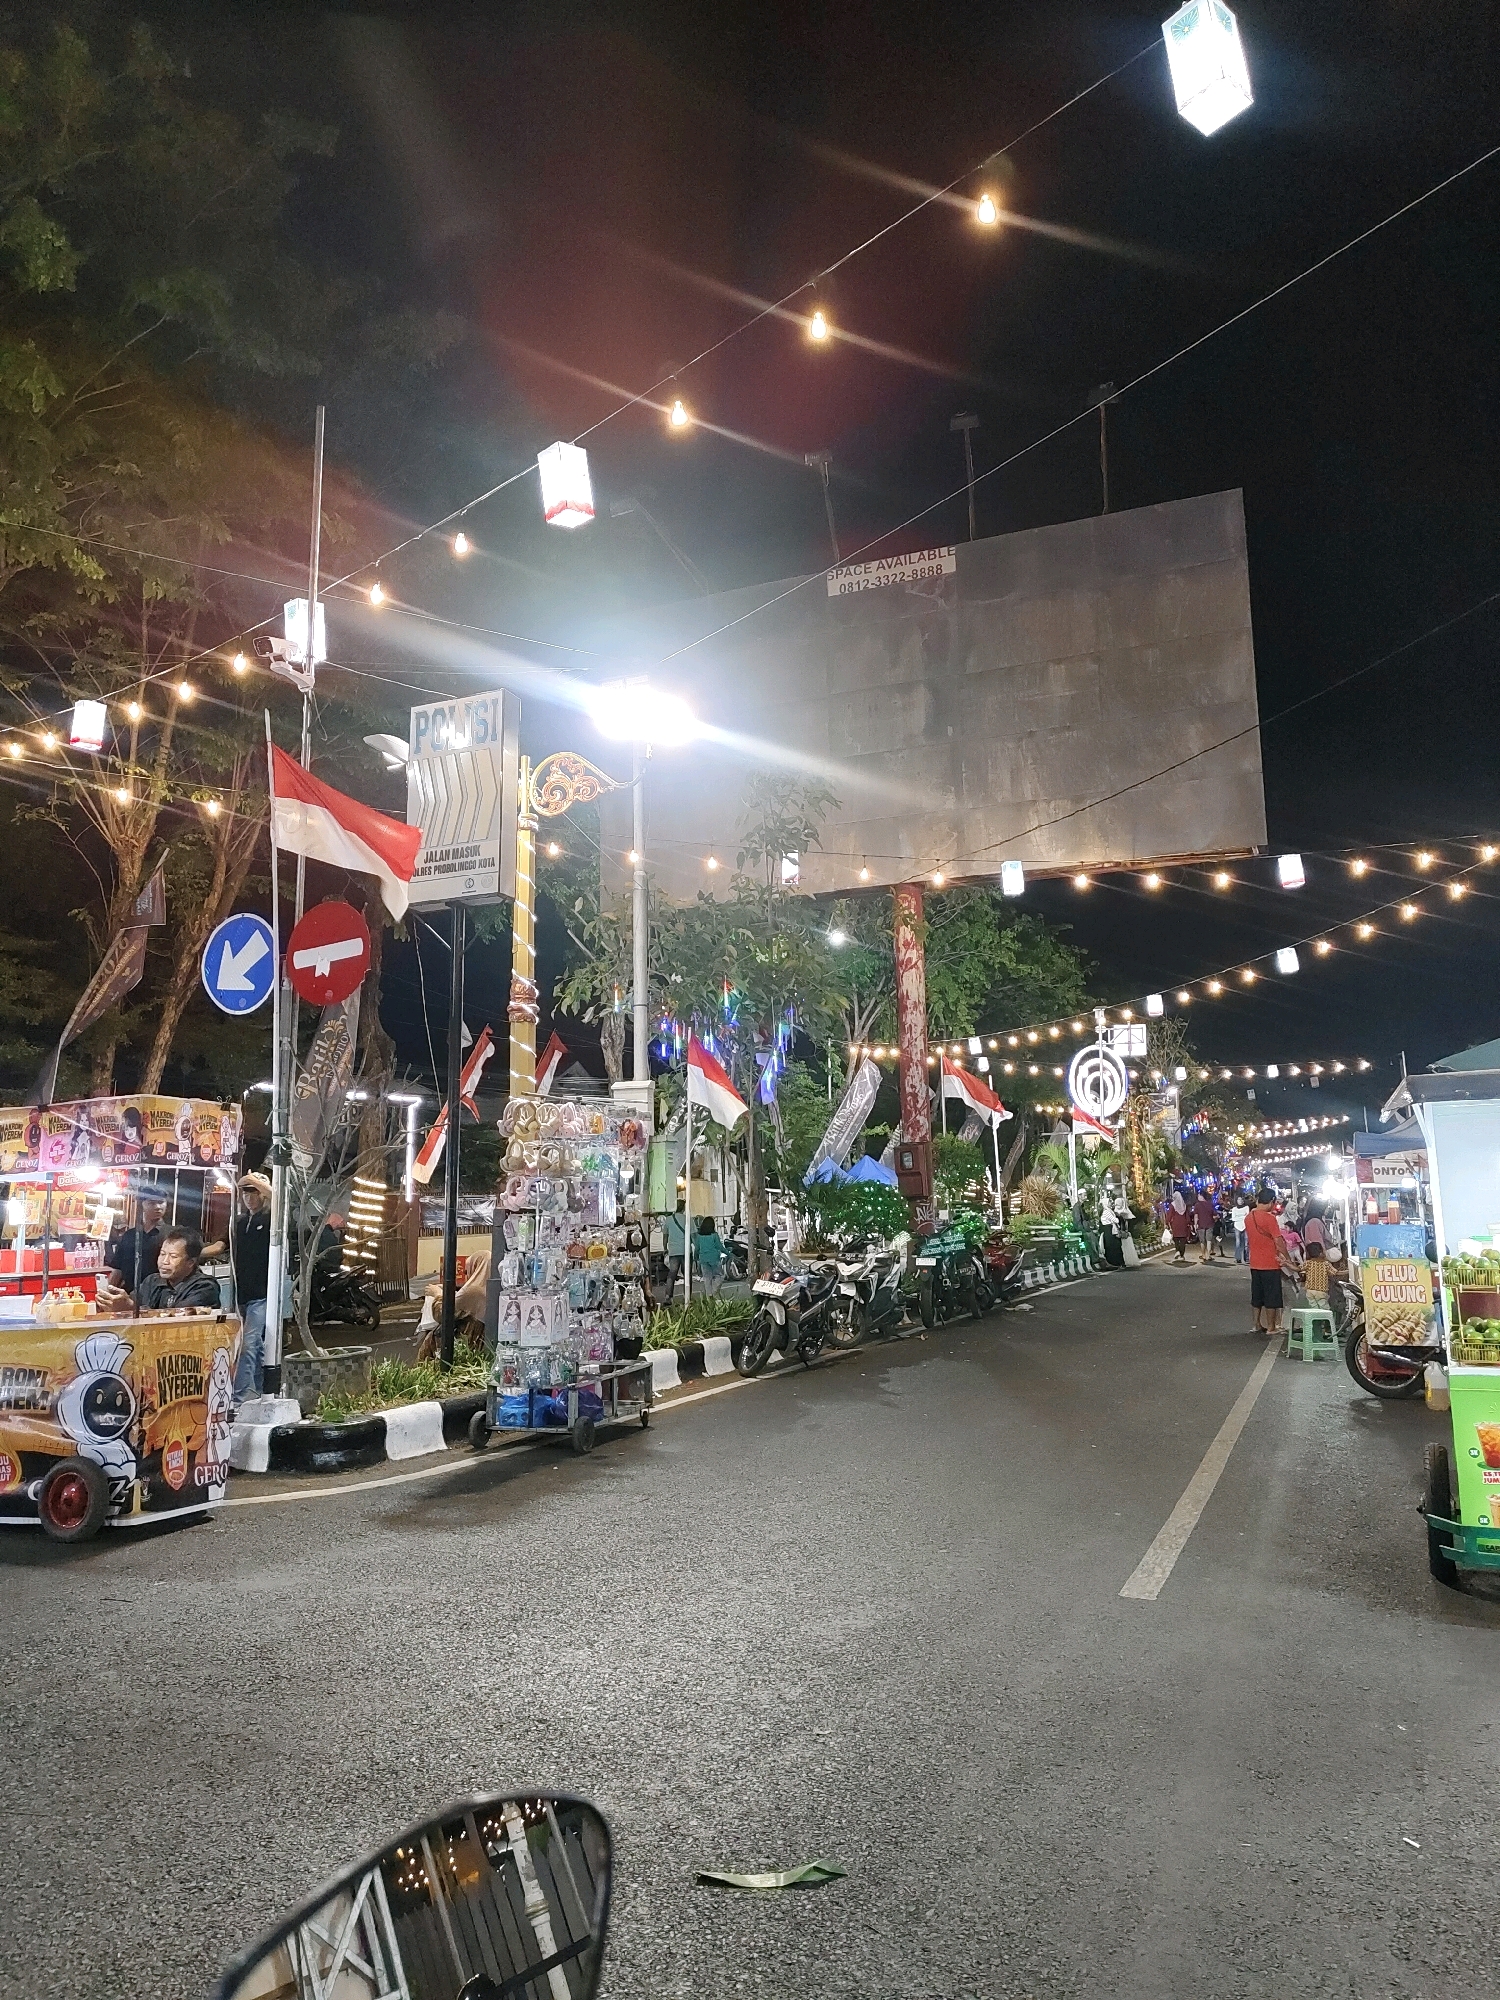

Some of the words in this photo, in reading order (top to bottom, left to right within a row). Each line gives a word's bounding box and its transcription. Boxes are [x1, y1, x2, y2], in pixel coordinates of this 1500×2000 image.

[827, 563, 872, 581] SPACE
[876, 547, 956, 572] AVAILABLE
[839, 564, 943, 593] 0812-3322-8888
[414, 698, 498, 754] POLISI
[424, 849, 451, 864] JALAN
[452, 845, 481, 860] MASUK
[433, 860, 477, 875] PROBOLINGGO
[478, 857, 495, 869] KOTA
[295, 1031, 333, 1099] Batik
[114, 1153, 140, 1163] GEROZ
[1375, 1263, 1418, 1283] TELUR
[1371, 1284, 1427, 1304] GULUNG
[156, 1354, 203, 1380] MAKRONI
[158, 1374, 204, 1407] NYEREM
